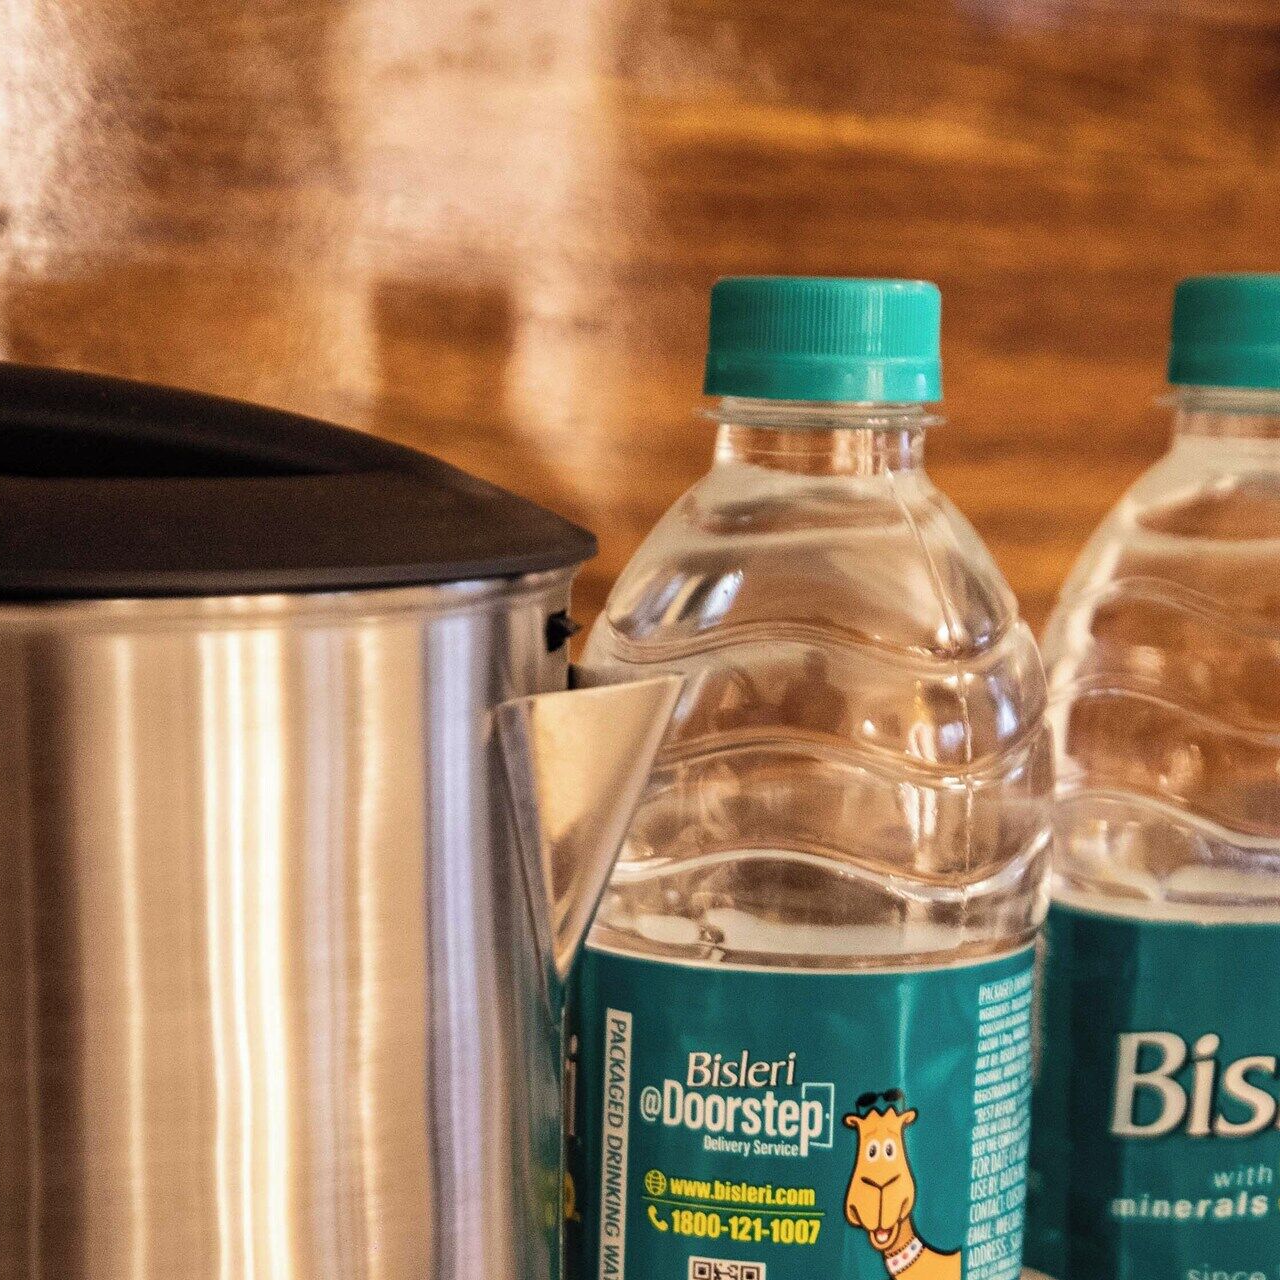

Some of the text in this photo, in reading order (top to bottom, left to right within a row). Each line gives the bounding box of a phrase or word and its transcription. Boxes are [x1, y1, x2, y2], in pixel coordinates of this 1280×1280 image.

[606, 1017, 627, 1129] PACKAGED
[686, 1050, 797, 1087] Bisleri
[640, 1079, 823, 1157] @Doorstep
[703, 1135, 799, 1157] Delivery Service
[604, 1133, 624, 1239] DRINKING
[670, 1177, 817, 1206] www.bisleri.com
[1212, 1163, 1273, 1189] with
[1111, 1192, 1270, 1220] minerals
[671, 1209, 822, 1245] 1800-121-1007
